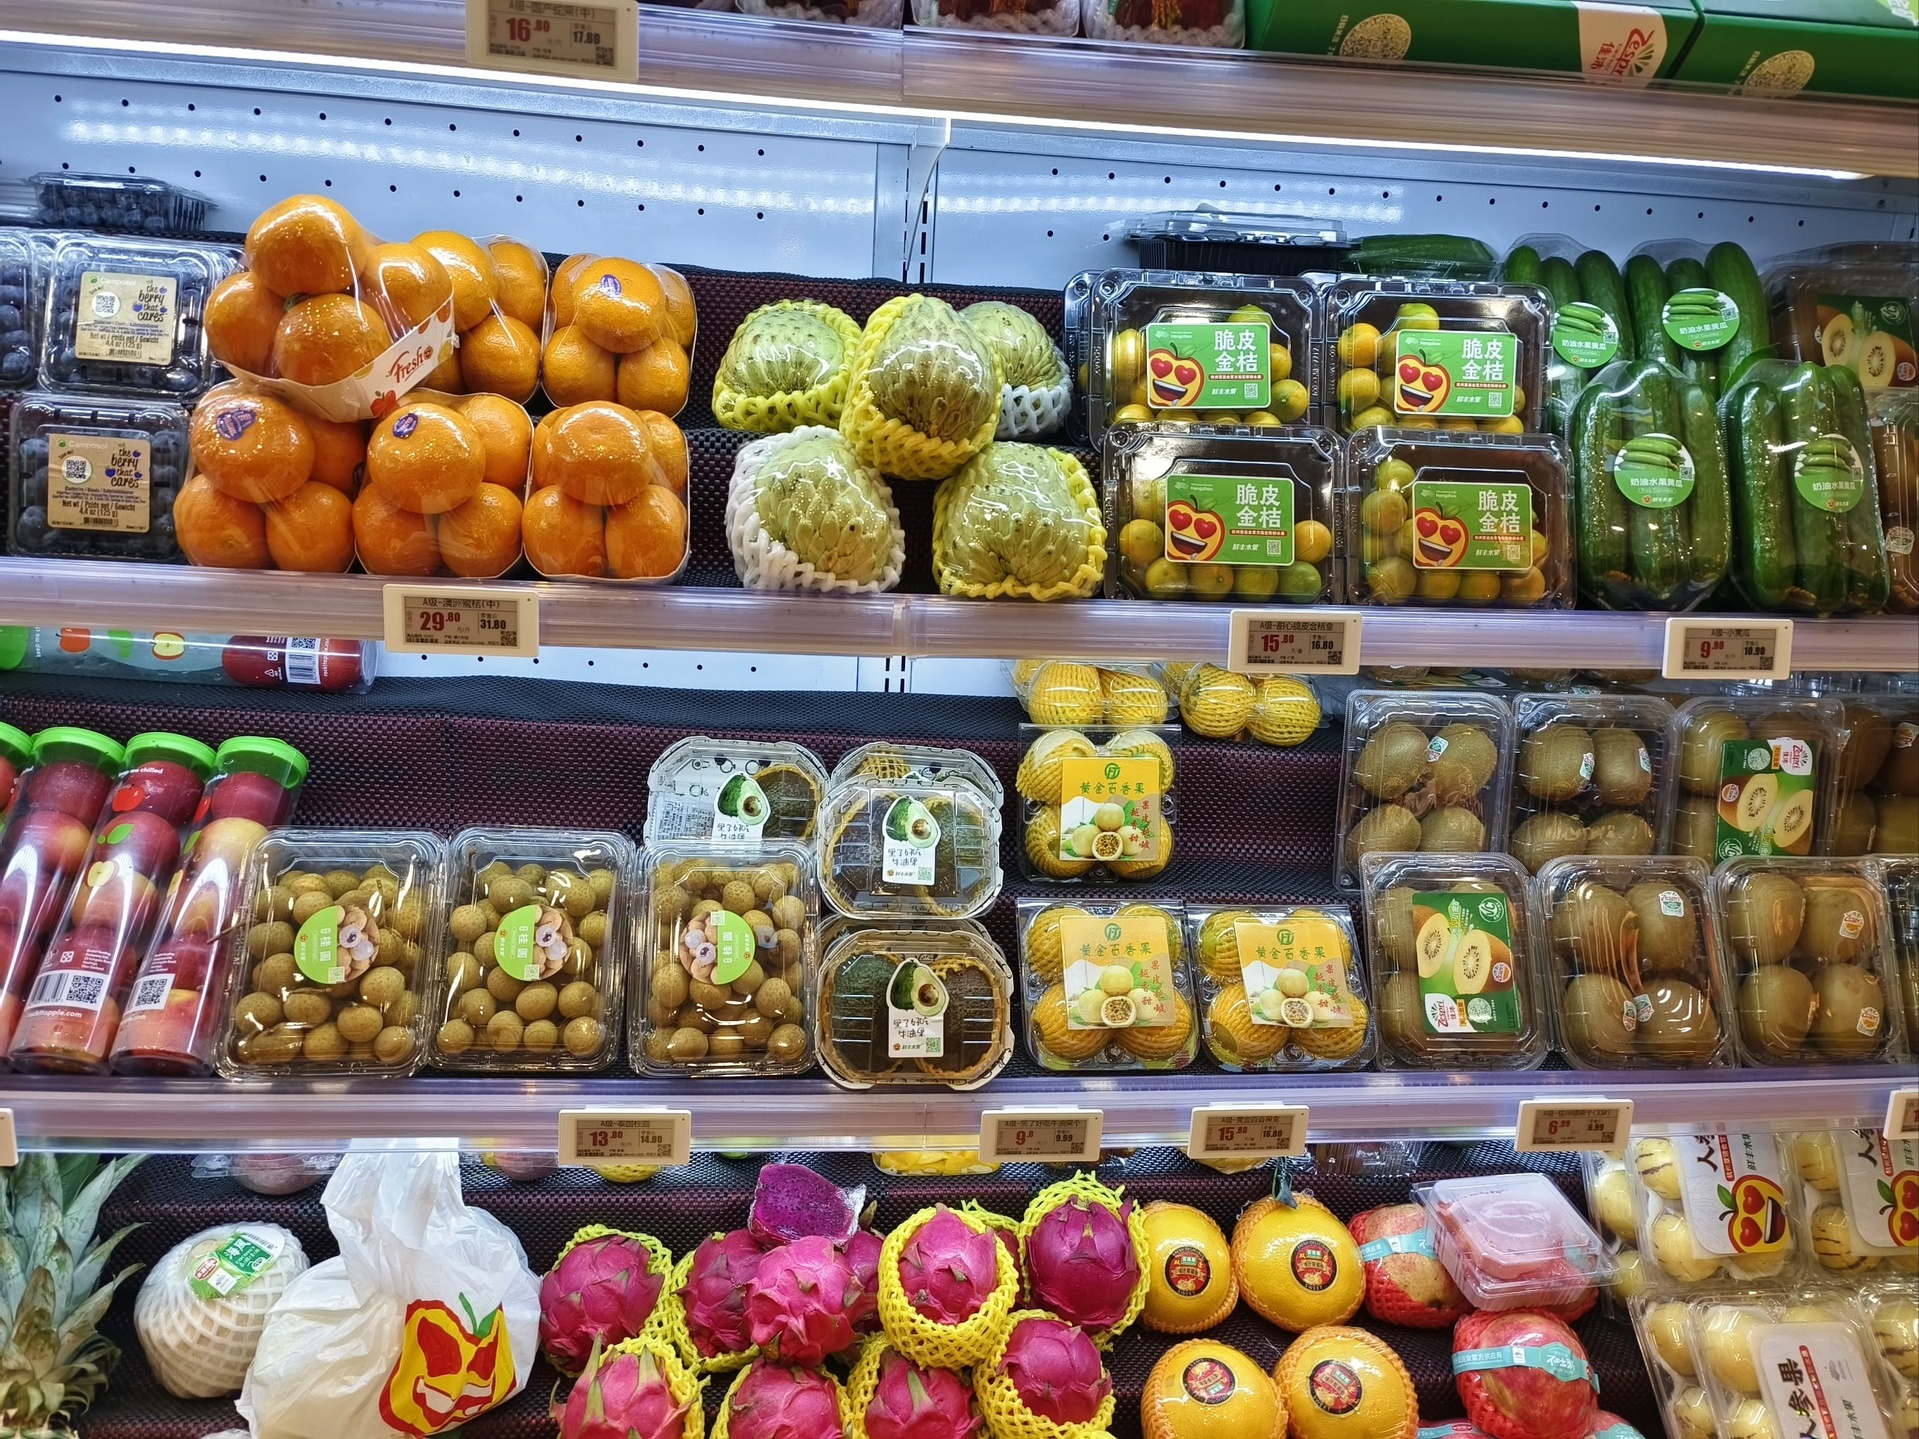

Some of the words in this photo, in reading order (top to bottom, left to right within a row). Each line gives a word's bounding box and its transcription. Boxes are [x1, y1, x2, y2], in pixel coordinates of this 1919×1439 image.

[507, 17, 551, 42] 16.80
[574, 31, 602, 45] 17.80
[147, 284, 158, 293] the
[139, 290, 165, 305] berry
[143, 303, 159, 311] that
[137, 312, 164, 322] cares
[1213, 329, 1257, 351] 脆皮
[1461, 338, 1504, 360] 脆皮
[389, 346, 424, 383] Fresh
[1214, 351, 1258, 372] 金桔
[1461, 360, 1504, 381] 金桔
[68, 441, 108, 449] Camposol
[119, 447, 131, 457] the
[111, 454, 139, 470] berry
[117, 468, 133, 476] that
[111, 478, 139, 488] cares
[1235, 483, 1281, 506] 脆皮
[1477, 489, 1519, 511] 脆皮
[1236, 506, 1282, 528] 金桔
[1478, 512, 1520, 533] 金桔
[420, 611, 461, 631] 29.80
[480, 619, 506, 629] 31.80
[1261, 634, 1294, 652] 15.80
[1311, 640, 1334, 650] 16.80
[1700, 640, 1725, 658] 9.90
[1744, 646, 1766, 656] 10.90
[1080, 782, 1145, 795] 黄金百香果
[892, 857, 917, 866] 牛油果
[1080, 942, 1151, 957] 黄金百香果
[1256, 946, 1326, 960] 黄金百香果
[1438, 1000, 1448, 1027] Zespri
[898, 1027, 925, 1038] 牛油果
[1218, 1126, 1248, 1141] 15.80
[1548, 1120, 1571, 1134] 6.99
[589, 1130, 623, 1147] 13.80
[640, 1135, 663, 1144] 14.80
[1056, 1134, 1073, 1142] 9.99
[1305, 1283, 1323, 1291] SWEET
[1313, 1394, 1331, 1412] SWEET
